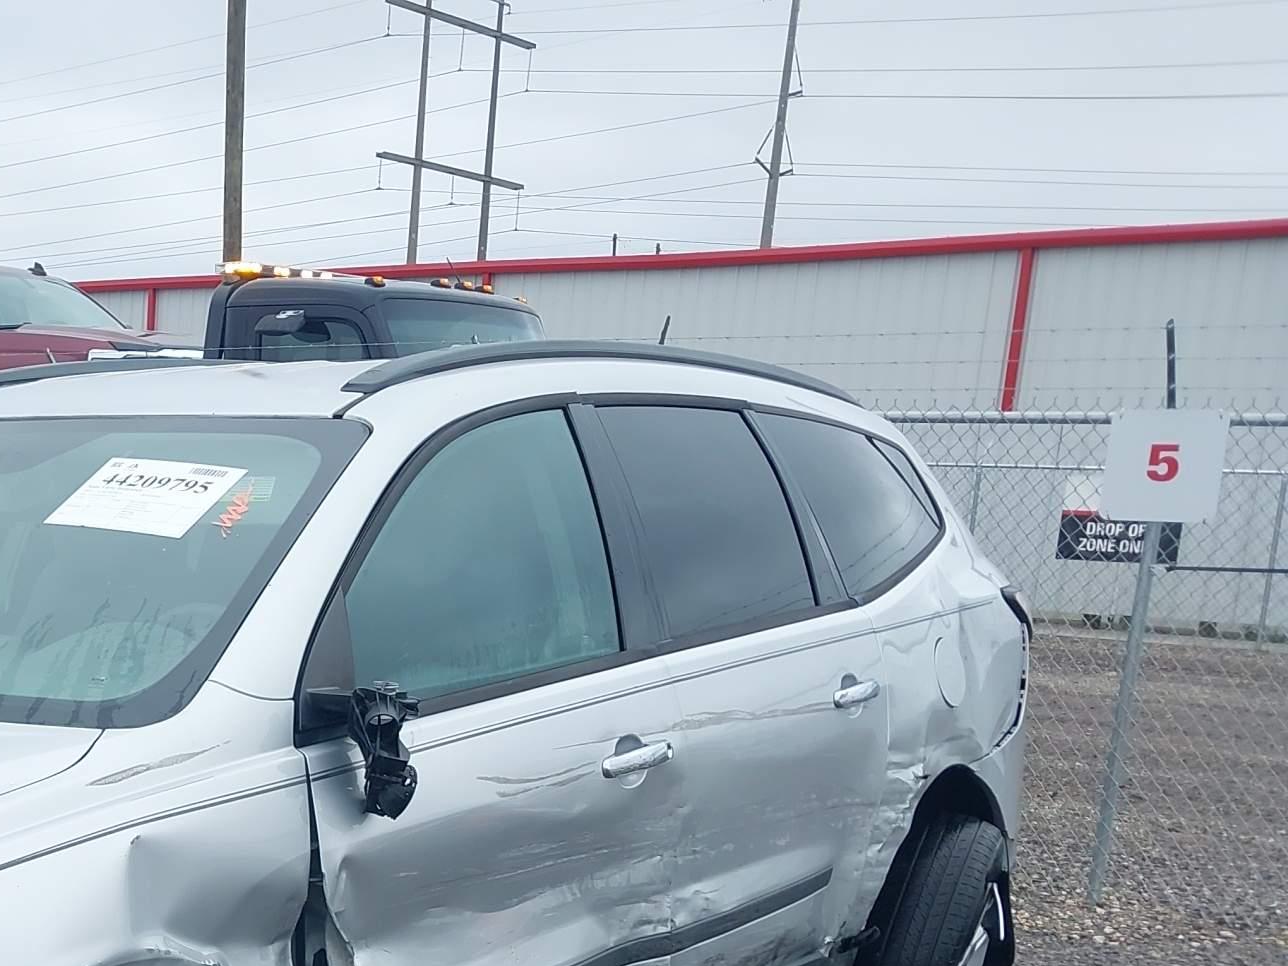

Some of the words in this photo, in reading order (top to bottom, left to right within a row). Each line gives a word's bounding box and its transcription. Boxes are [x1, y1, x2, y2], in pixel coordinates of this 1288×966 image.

[1146, 443, 1180, 482] 5
[102, 473, 215, 495] 44209795
[1086, 522, 1124, 536] DROP
[1128, 524, 1147, 537] OF
[1078, 538, 1116, 552] ZONE
[1119, 539, 1144, 553] ON
